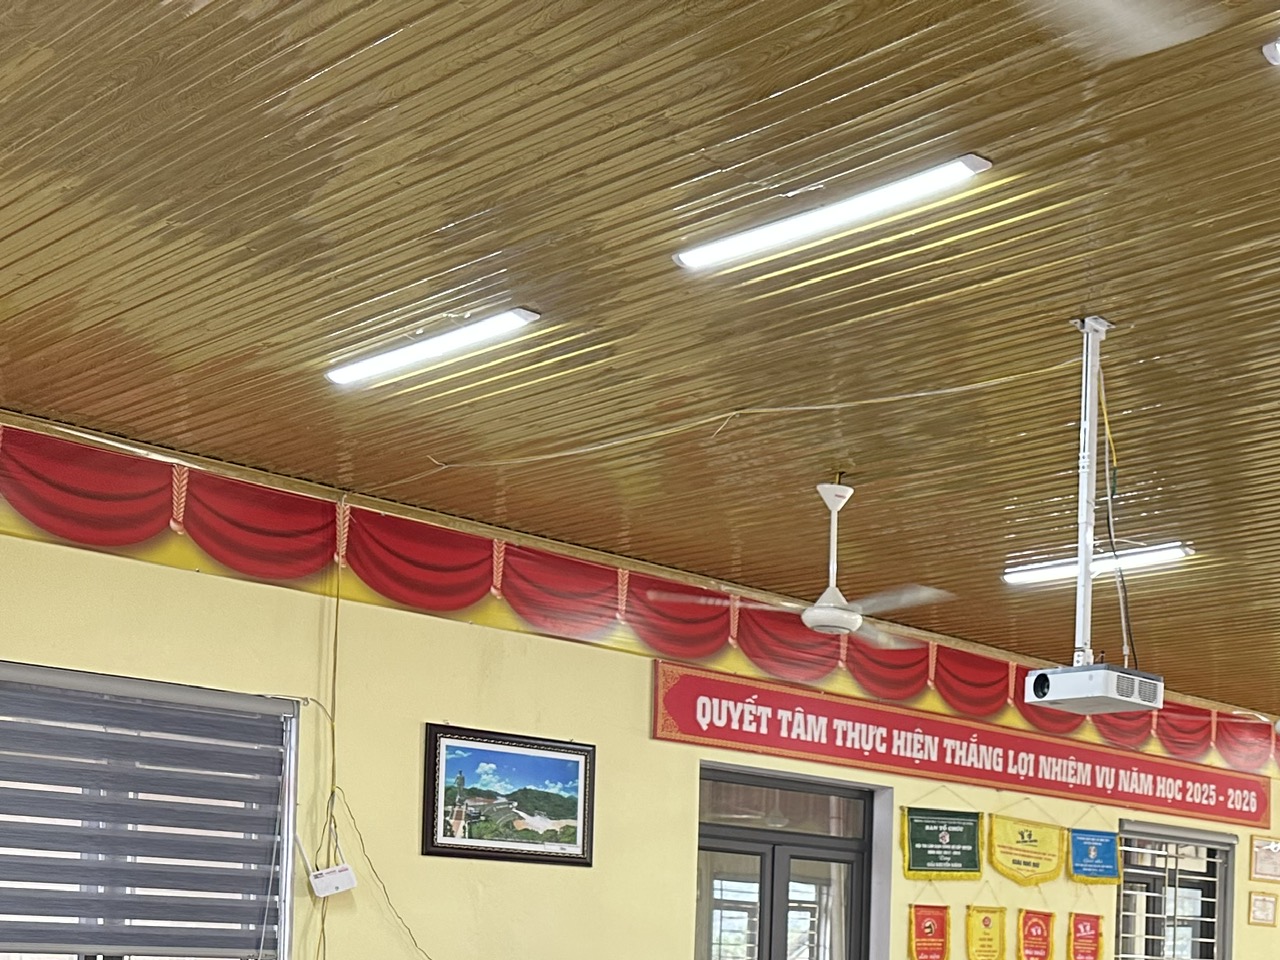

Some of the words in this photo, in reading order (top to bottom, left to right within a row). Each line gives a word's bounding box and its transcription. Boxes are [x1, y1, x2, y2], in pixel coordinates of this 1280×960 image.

[696, 694, 772, 735] QUYẾT
[777, 707, 828, 745] TÂM
[833, 718, 887, 756] THỰC
[891, 728, 940, 764] HIỆN
[943, 733, 1003, 772] THẮNG
[1007, 750, 1035, 780] LỢI
[1038, 756, 1092, 789] NHIỆM
[1095, 765, 1116, 794] VỤ
[1118, 767, 1154, 797] NĂM
[1155, 776, 1183, 803] HỌC
[1185, 782, 1217, 806] 2025
[1227, 788, 1258, 813] 2026
